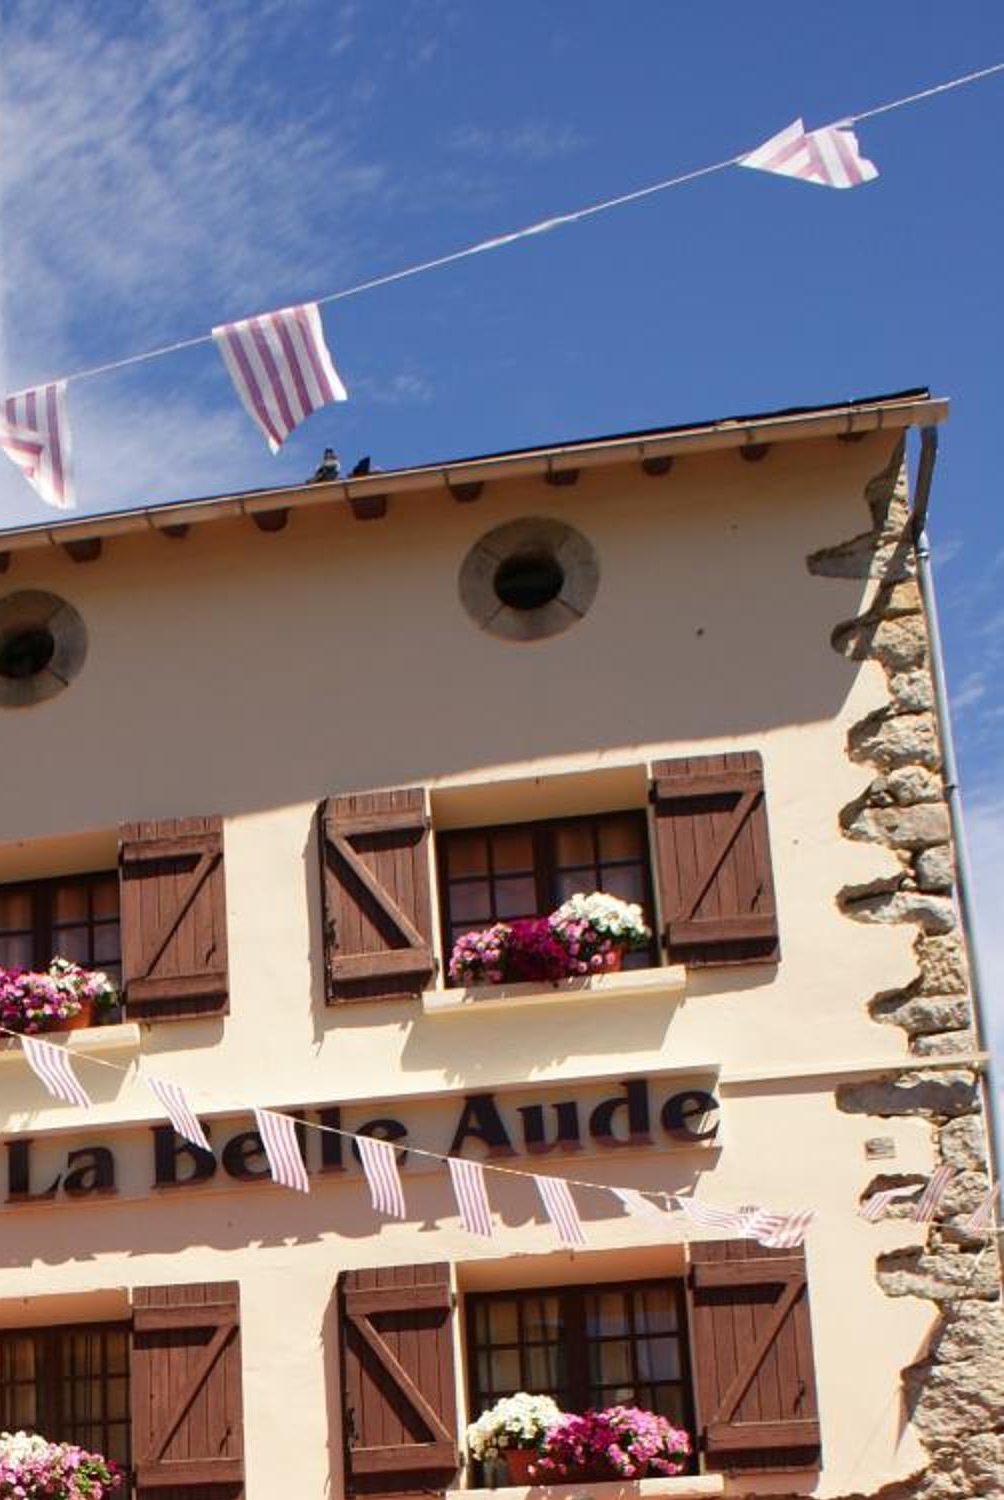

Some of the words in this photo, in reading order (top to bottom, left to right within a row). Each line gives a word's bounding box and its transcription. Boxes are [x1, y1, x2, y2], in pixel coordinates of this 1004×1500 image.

[3, 1138, 116, 1202] La
[149, 1106, 408, 1189] Belle
[448, 1078, 721, 1160] Aude
